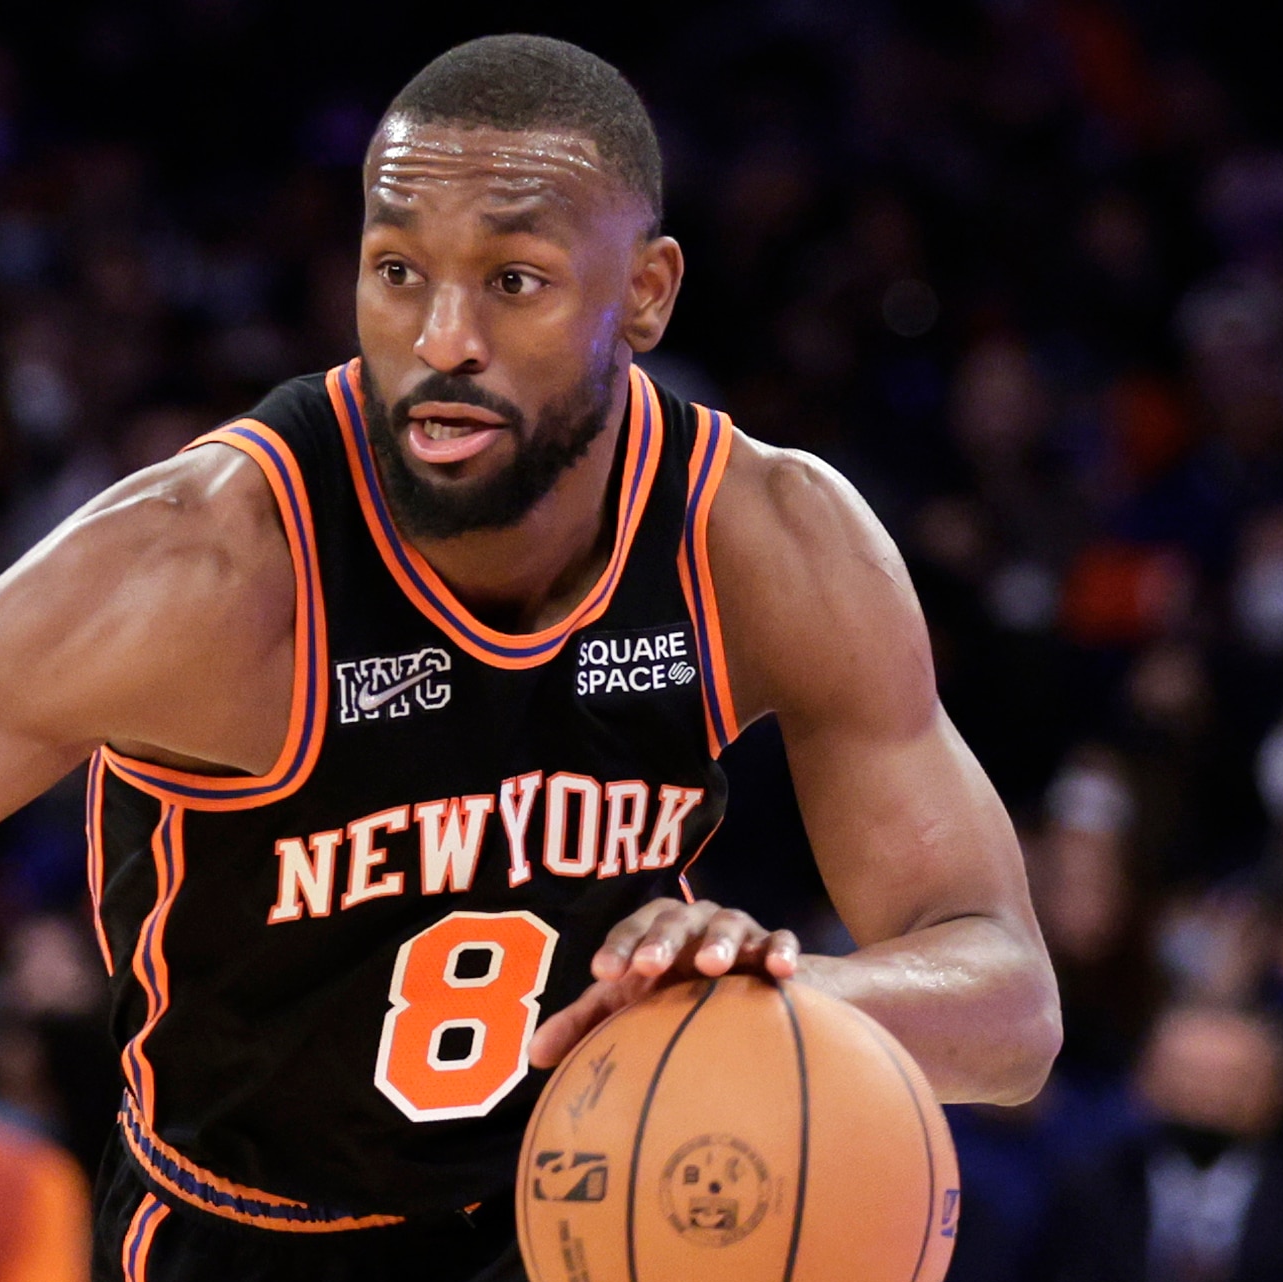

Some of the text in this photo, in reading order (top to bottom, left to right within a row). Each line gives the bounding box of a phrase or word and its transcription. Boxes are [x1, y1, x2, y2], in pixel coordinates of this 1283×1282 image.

[336, 647, 451, 723] NYC
[577, 668, 667, 695] SPACE
[578, 632, 687, 667] SQUARE
[267, 769, 704, 924] NEW YORK
[374, 910, 560, 1122] 8
